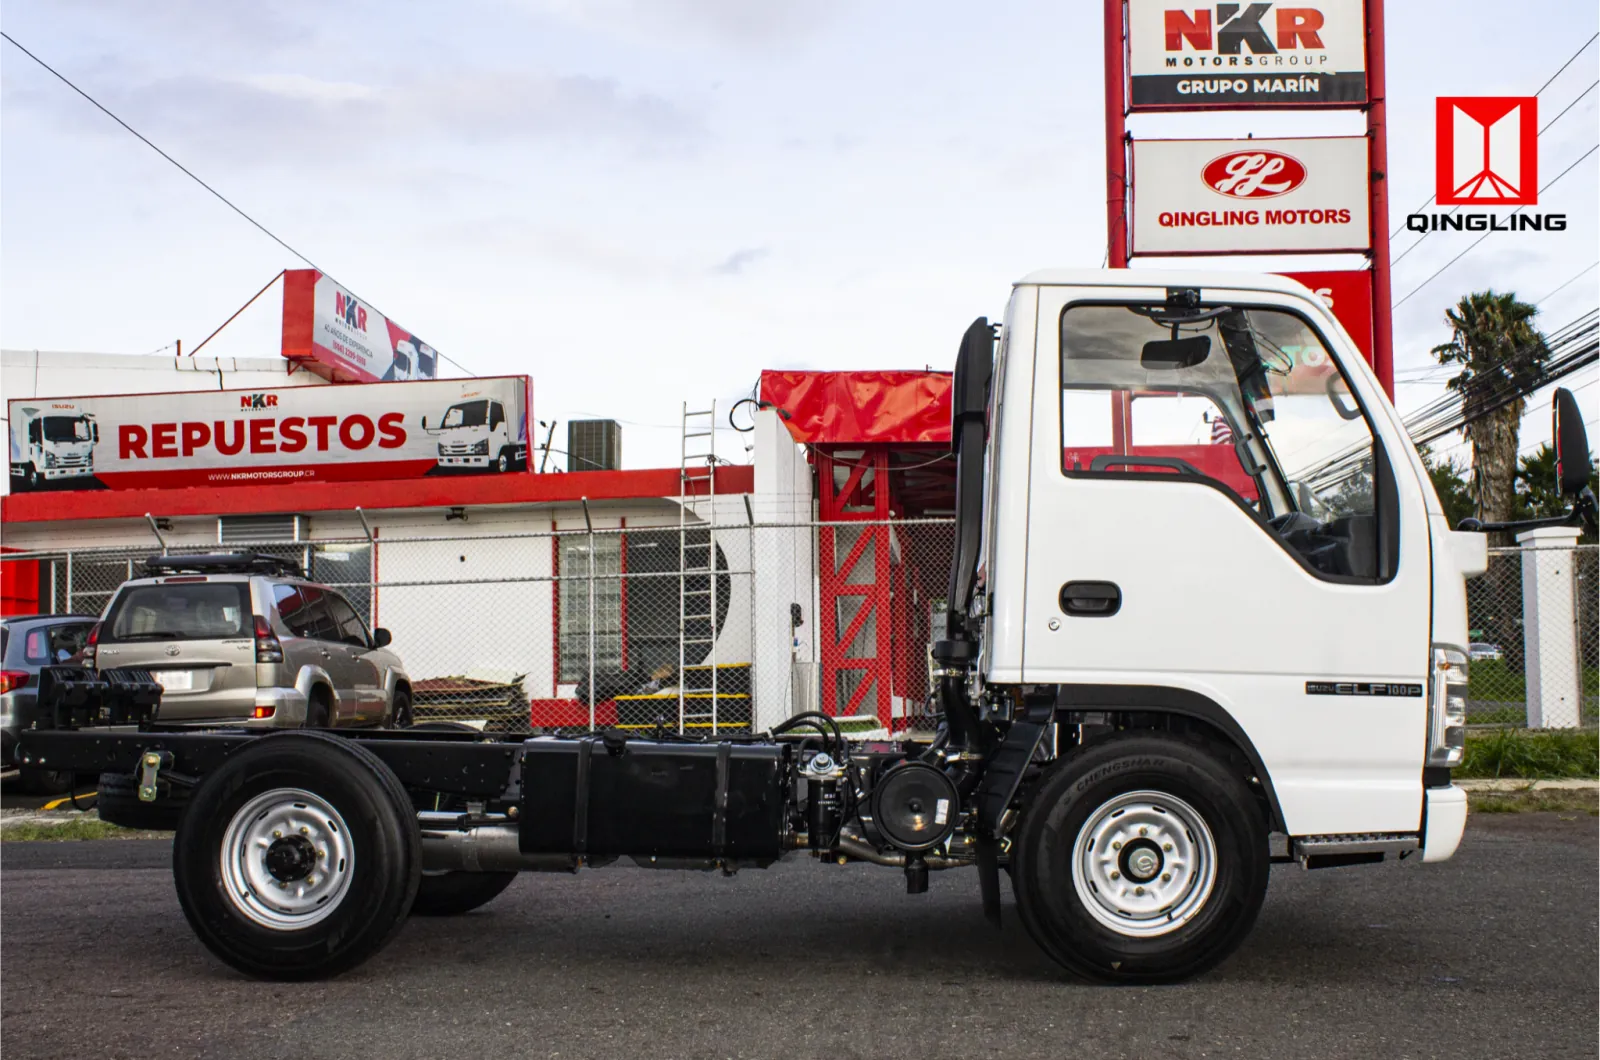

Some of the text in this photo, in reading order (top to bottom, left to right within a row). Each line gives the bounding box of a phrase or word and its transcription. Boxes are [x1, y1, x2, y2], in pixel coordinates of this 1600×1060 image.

[1164, 3, 1325, 55] NKR
[1176, 75, 1320, 95] GRUPO MARÍN
[1158, 209, 1351, 228] QINGLING MOTORS
[335, 290, 368, 332] NKR
[240, 394, 279, 408] NKR
[119, 412, 408, 460] REPUESTOS
[208, 470, 315, 481] WWW.NKRMOTORSGROUP.CR
[1335, 683, 1387, 695] ELF
